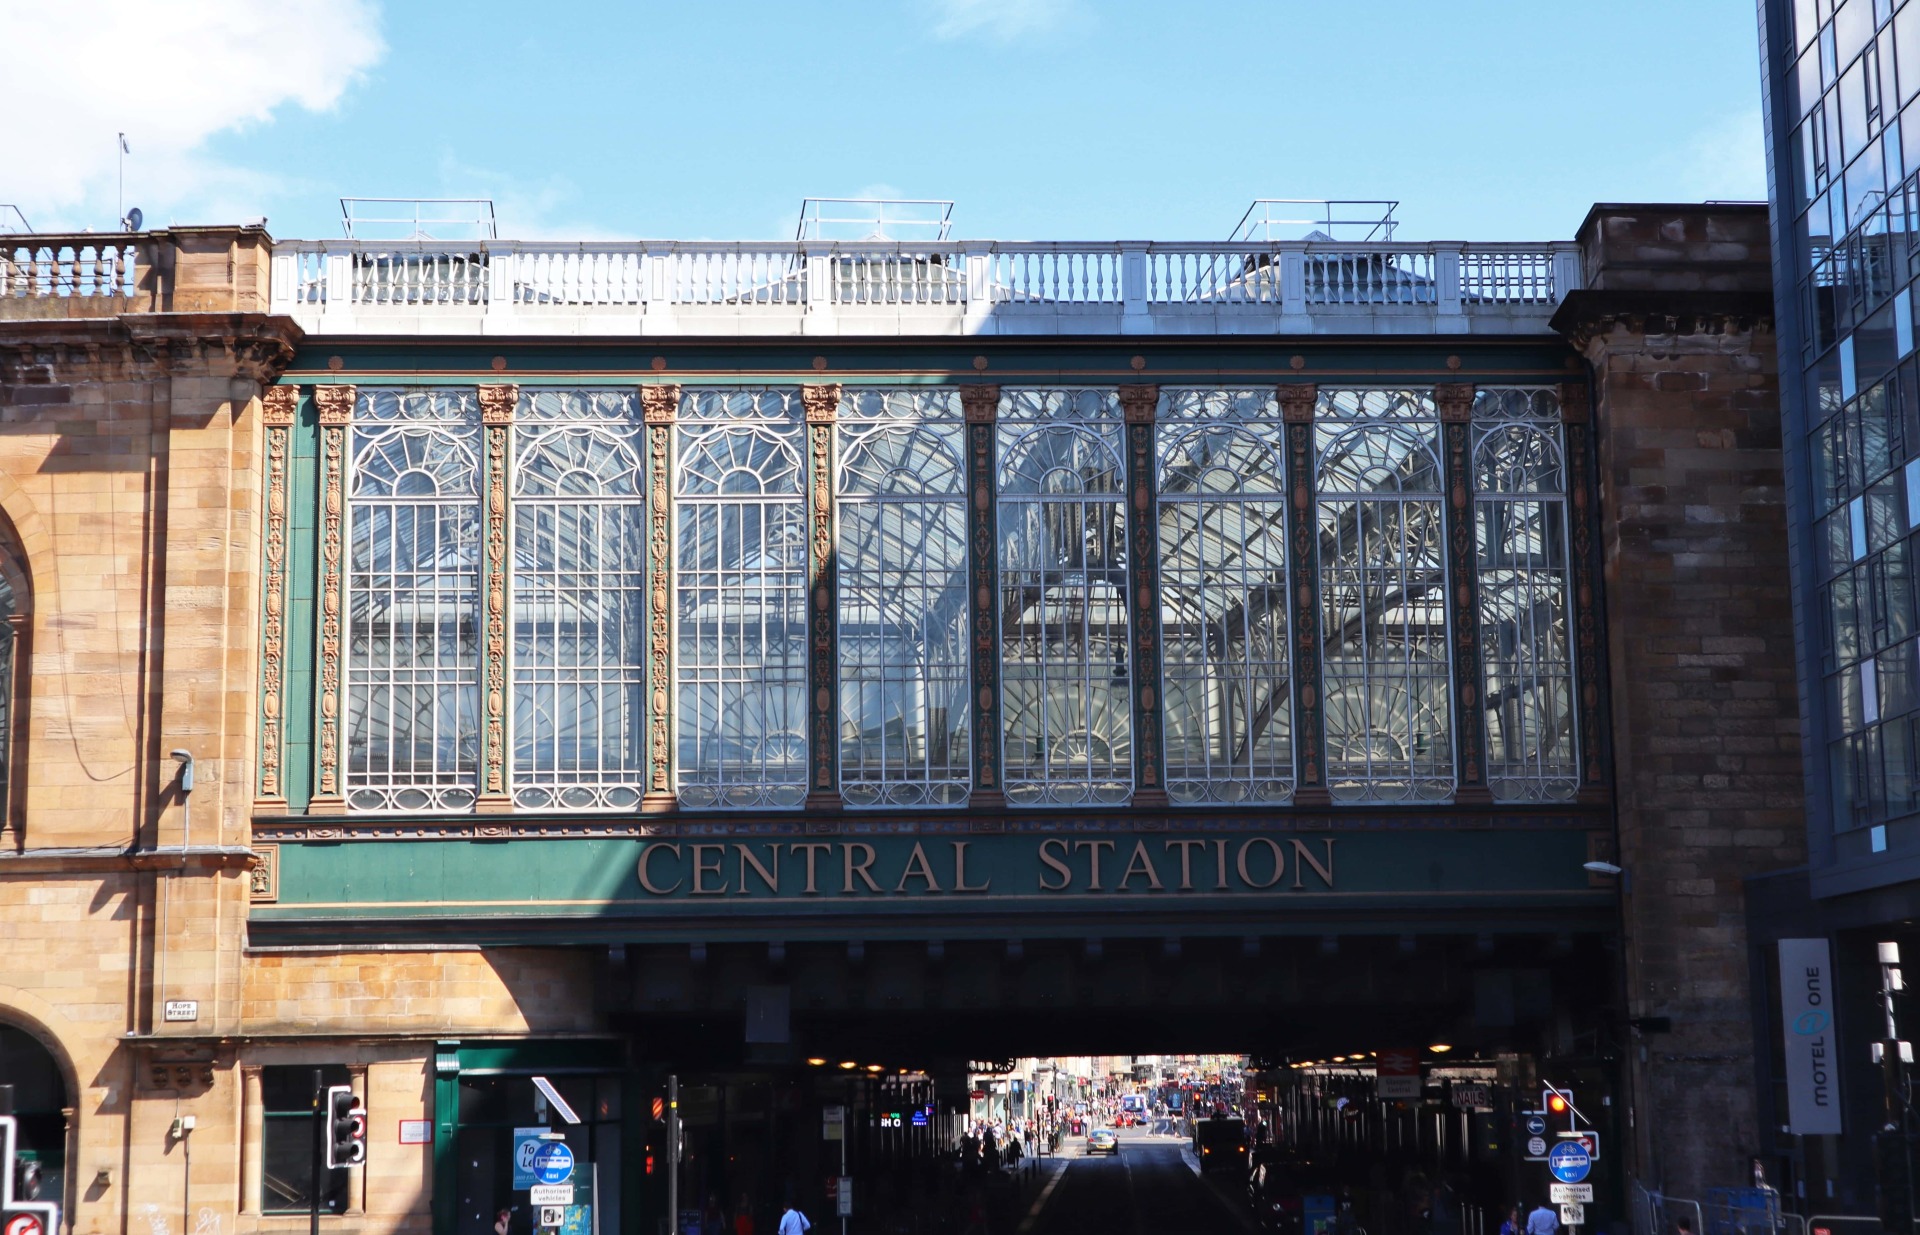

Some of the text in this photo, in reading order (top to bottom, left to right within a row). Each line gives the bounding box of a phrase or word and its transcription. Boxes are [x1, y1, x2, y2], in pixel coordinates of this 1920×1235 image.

[637, 837, 1337, 895] CENTRAL STATION
[1456, 1092, 1485, 1105] NAILS
[524, 1144, 535, 1155] To
[522, 1157, 534, 1168] Le
[1564, 1170, 1577, 1178] taxi
[533, 1187, 571, 1195] Authorised
[1553, 1186, 1590, 1194] Authorised
